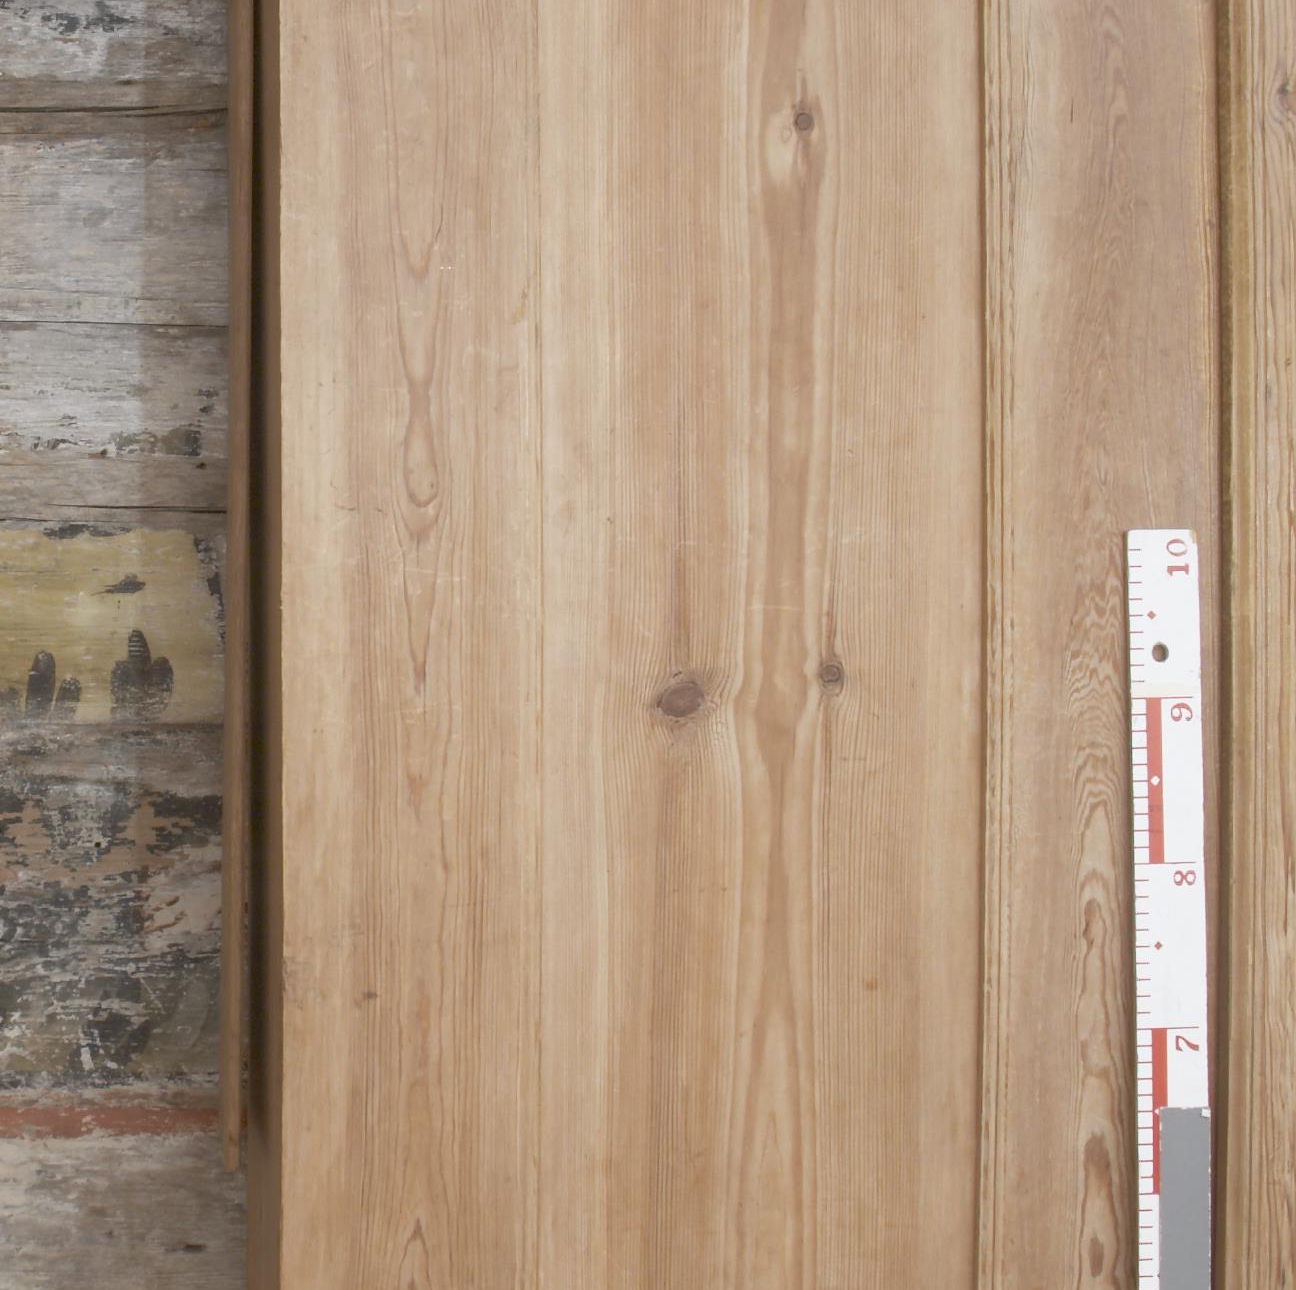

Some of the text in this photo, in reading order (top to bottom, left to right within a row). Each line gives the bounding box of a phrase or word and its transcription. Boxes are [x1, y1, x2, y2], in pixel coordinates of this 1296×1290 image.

[1166, 537, 1190, 577] 10
[1170, 700, 1193, 723] 9
[1173, 869, 1197, 887] 8
[1175, 1034, 1201, 1053] 7
